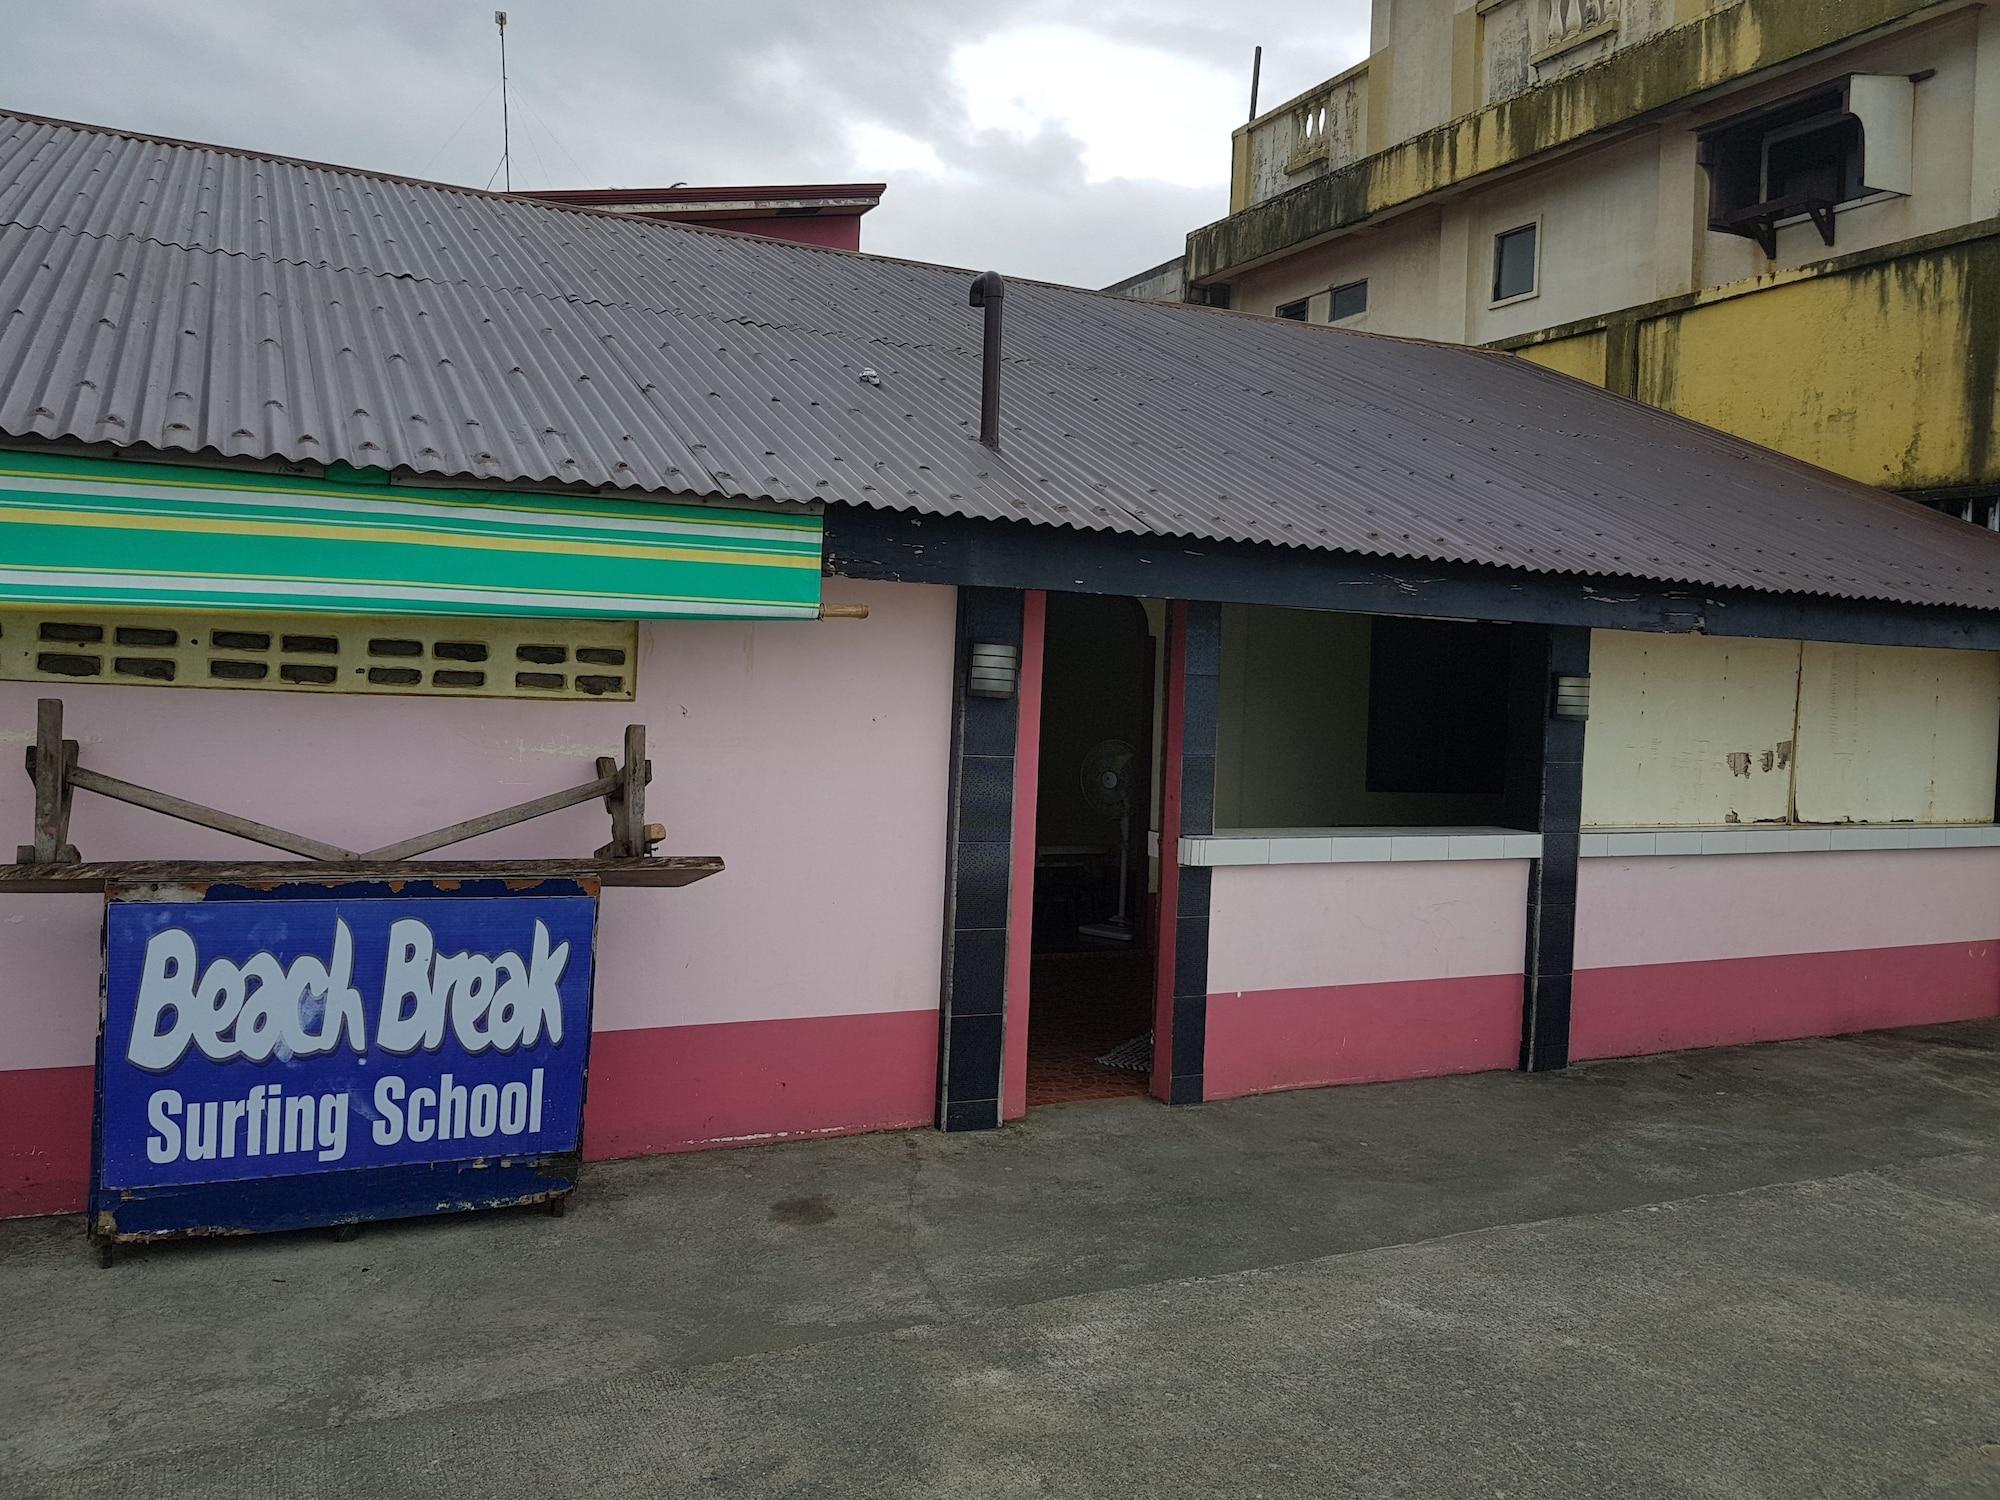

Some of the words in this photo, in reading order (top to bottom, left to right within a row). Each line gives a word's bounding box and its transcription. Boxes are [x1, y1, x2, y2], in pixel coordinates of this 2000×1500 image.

[126, 914, 369, 1071] Beach
[375, 917, 571, 1057] Break
[146, 1084, 349, 1165] Surfing
[372, 1067, 546, 1147] School
